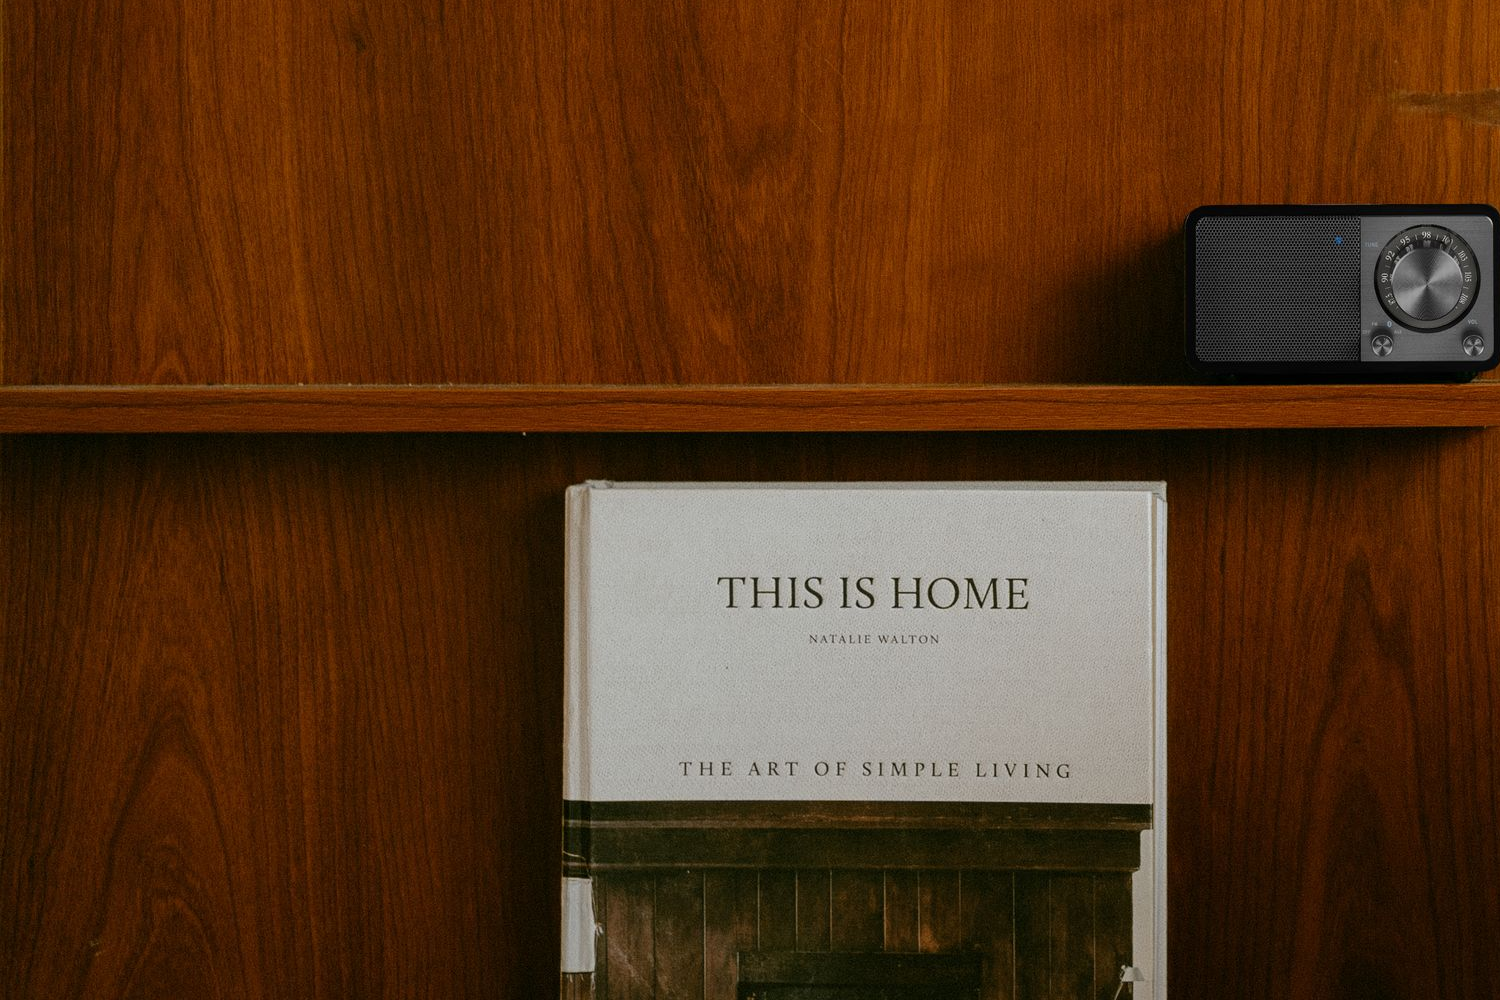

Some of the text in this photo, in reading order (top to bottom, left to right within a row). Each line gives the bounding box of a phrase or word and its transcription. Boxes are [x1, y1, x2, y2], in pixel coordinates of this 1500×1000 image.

[1400, 235, 1411, 245] 95
[1421, 231, 1432, 239] 98
[1384, 250, 1396, 261] 92
[1457, 250, 1468, 262] 103
[1381, 272, 1389, 283] 90
[1464, 271, 1472, 283] 105
[717, 576, 1030, 610] THIS IS HOME
[808, 634, 940, 645] NATALIE WALTON
[679, 761, 1071, 779] THE ART OF SIMPLE LIVING
